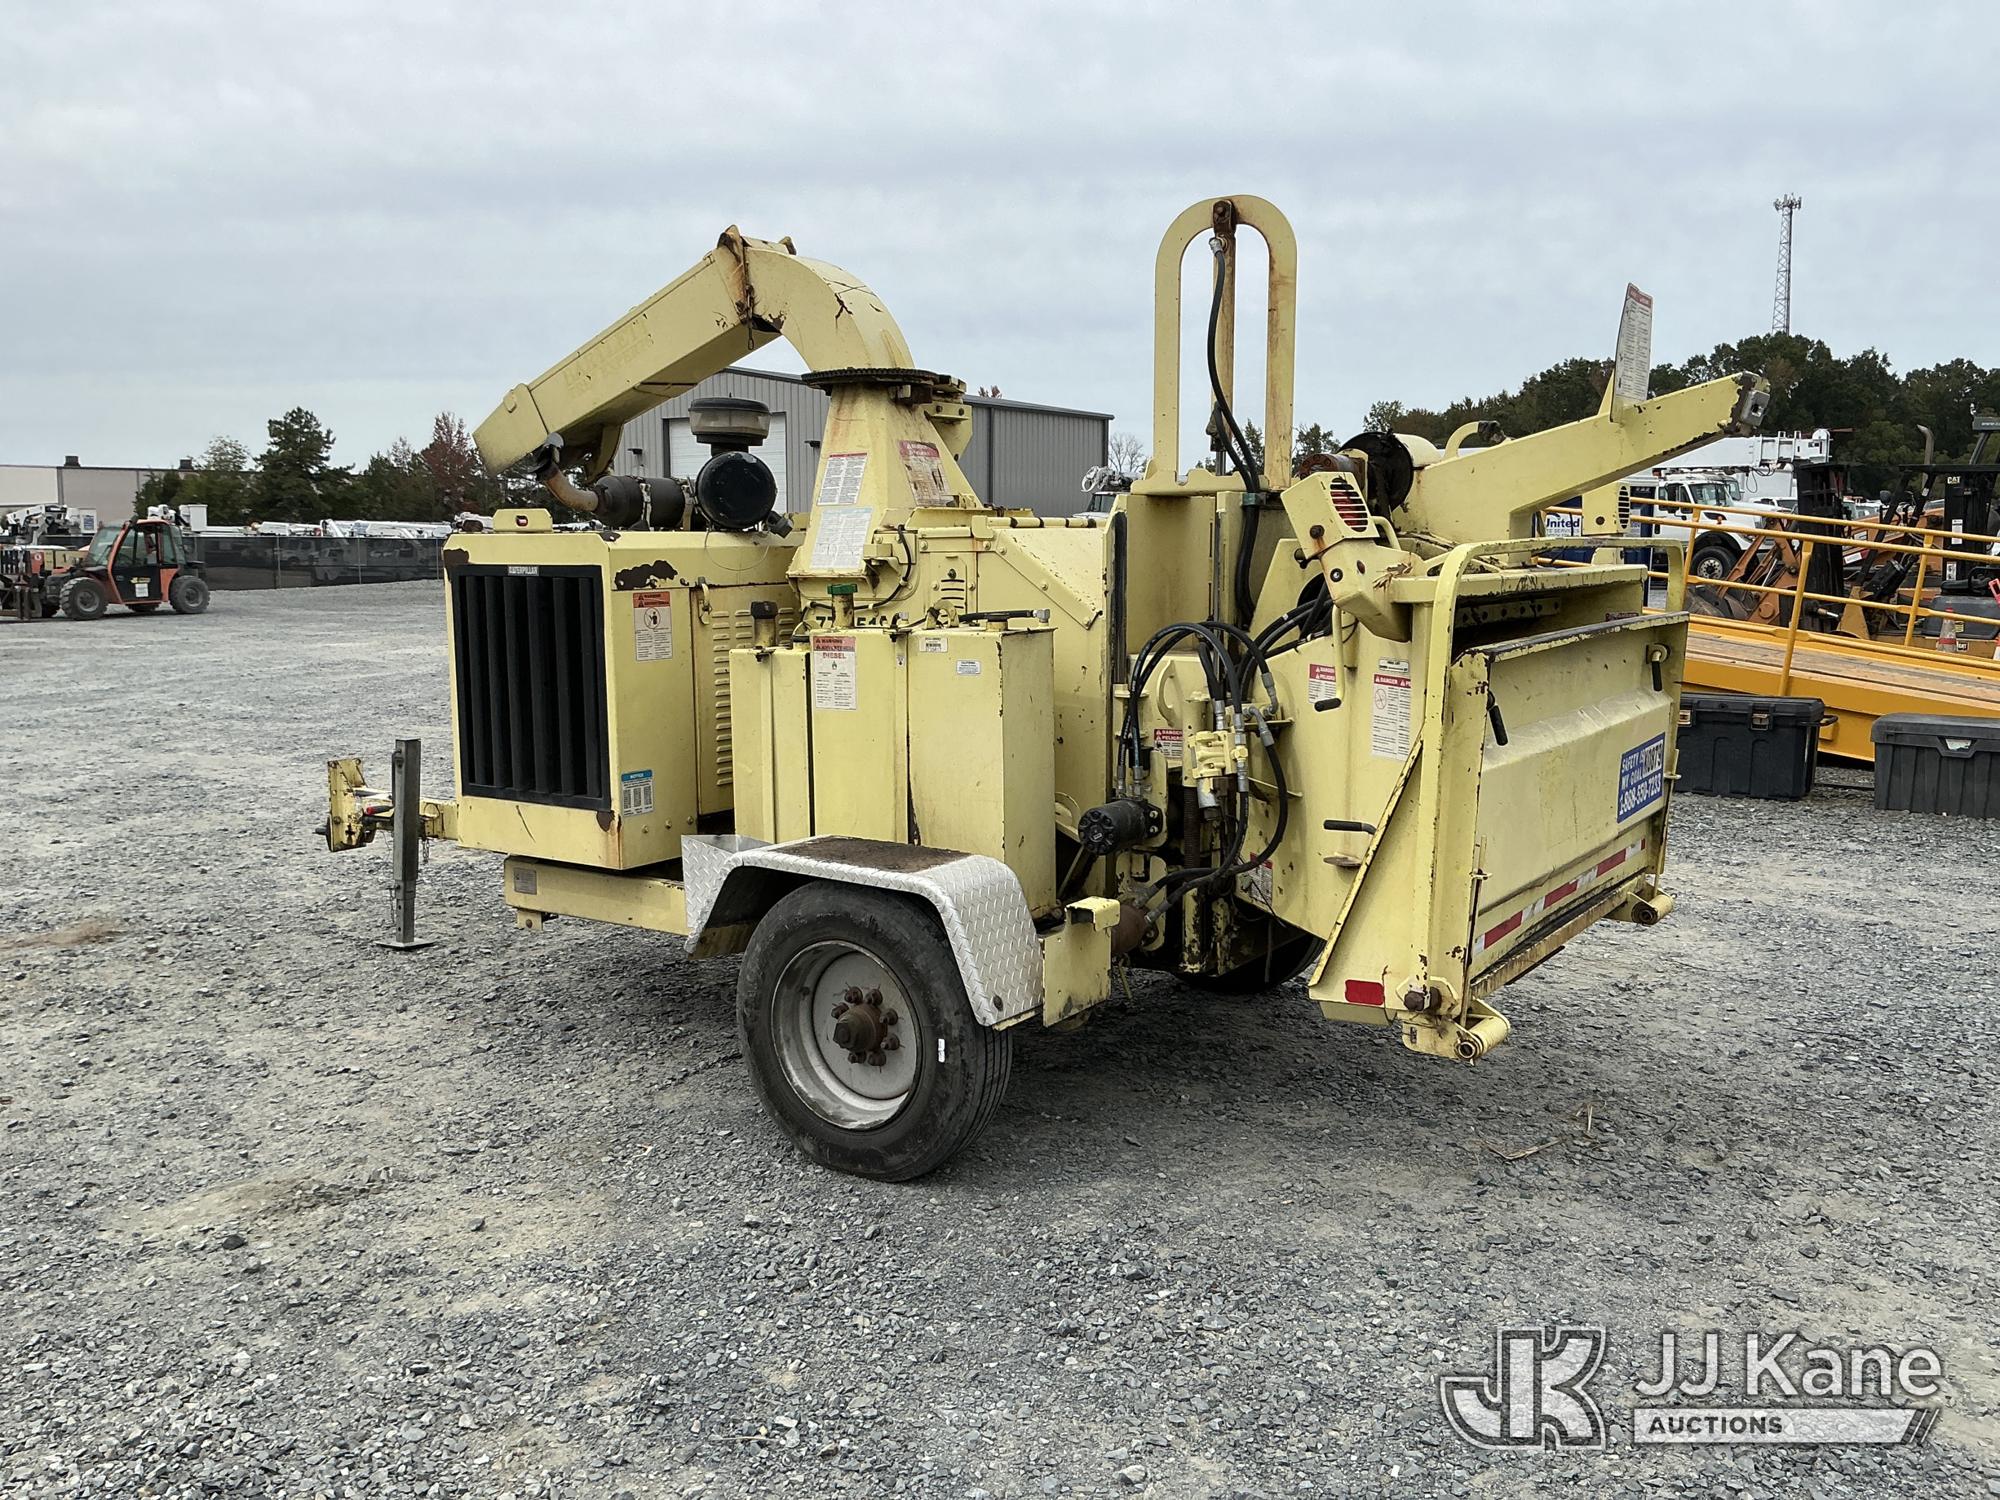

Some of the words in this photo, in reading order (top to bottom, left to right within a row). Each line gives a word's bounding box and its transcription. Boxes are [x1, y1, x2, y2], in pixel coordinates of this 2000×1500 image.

[1947, 476, 1960, 484] CAT
[1380, 677, 1398, 685] DANGER
[1622, 752, 1640, 774] SAFETY
[1621, 773, 1630, 791] MY
[1631, 765, 1644, 786] GOAL
